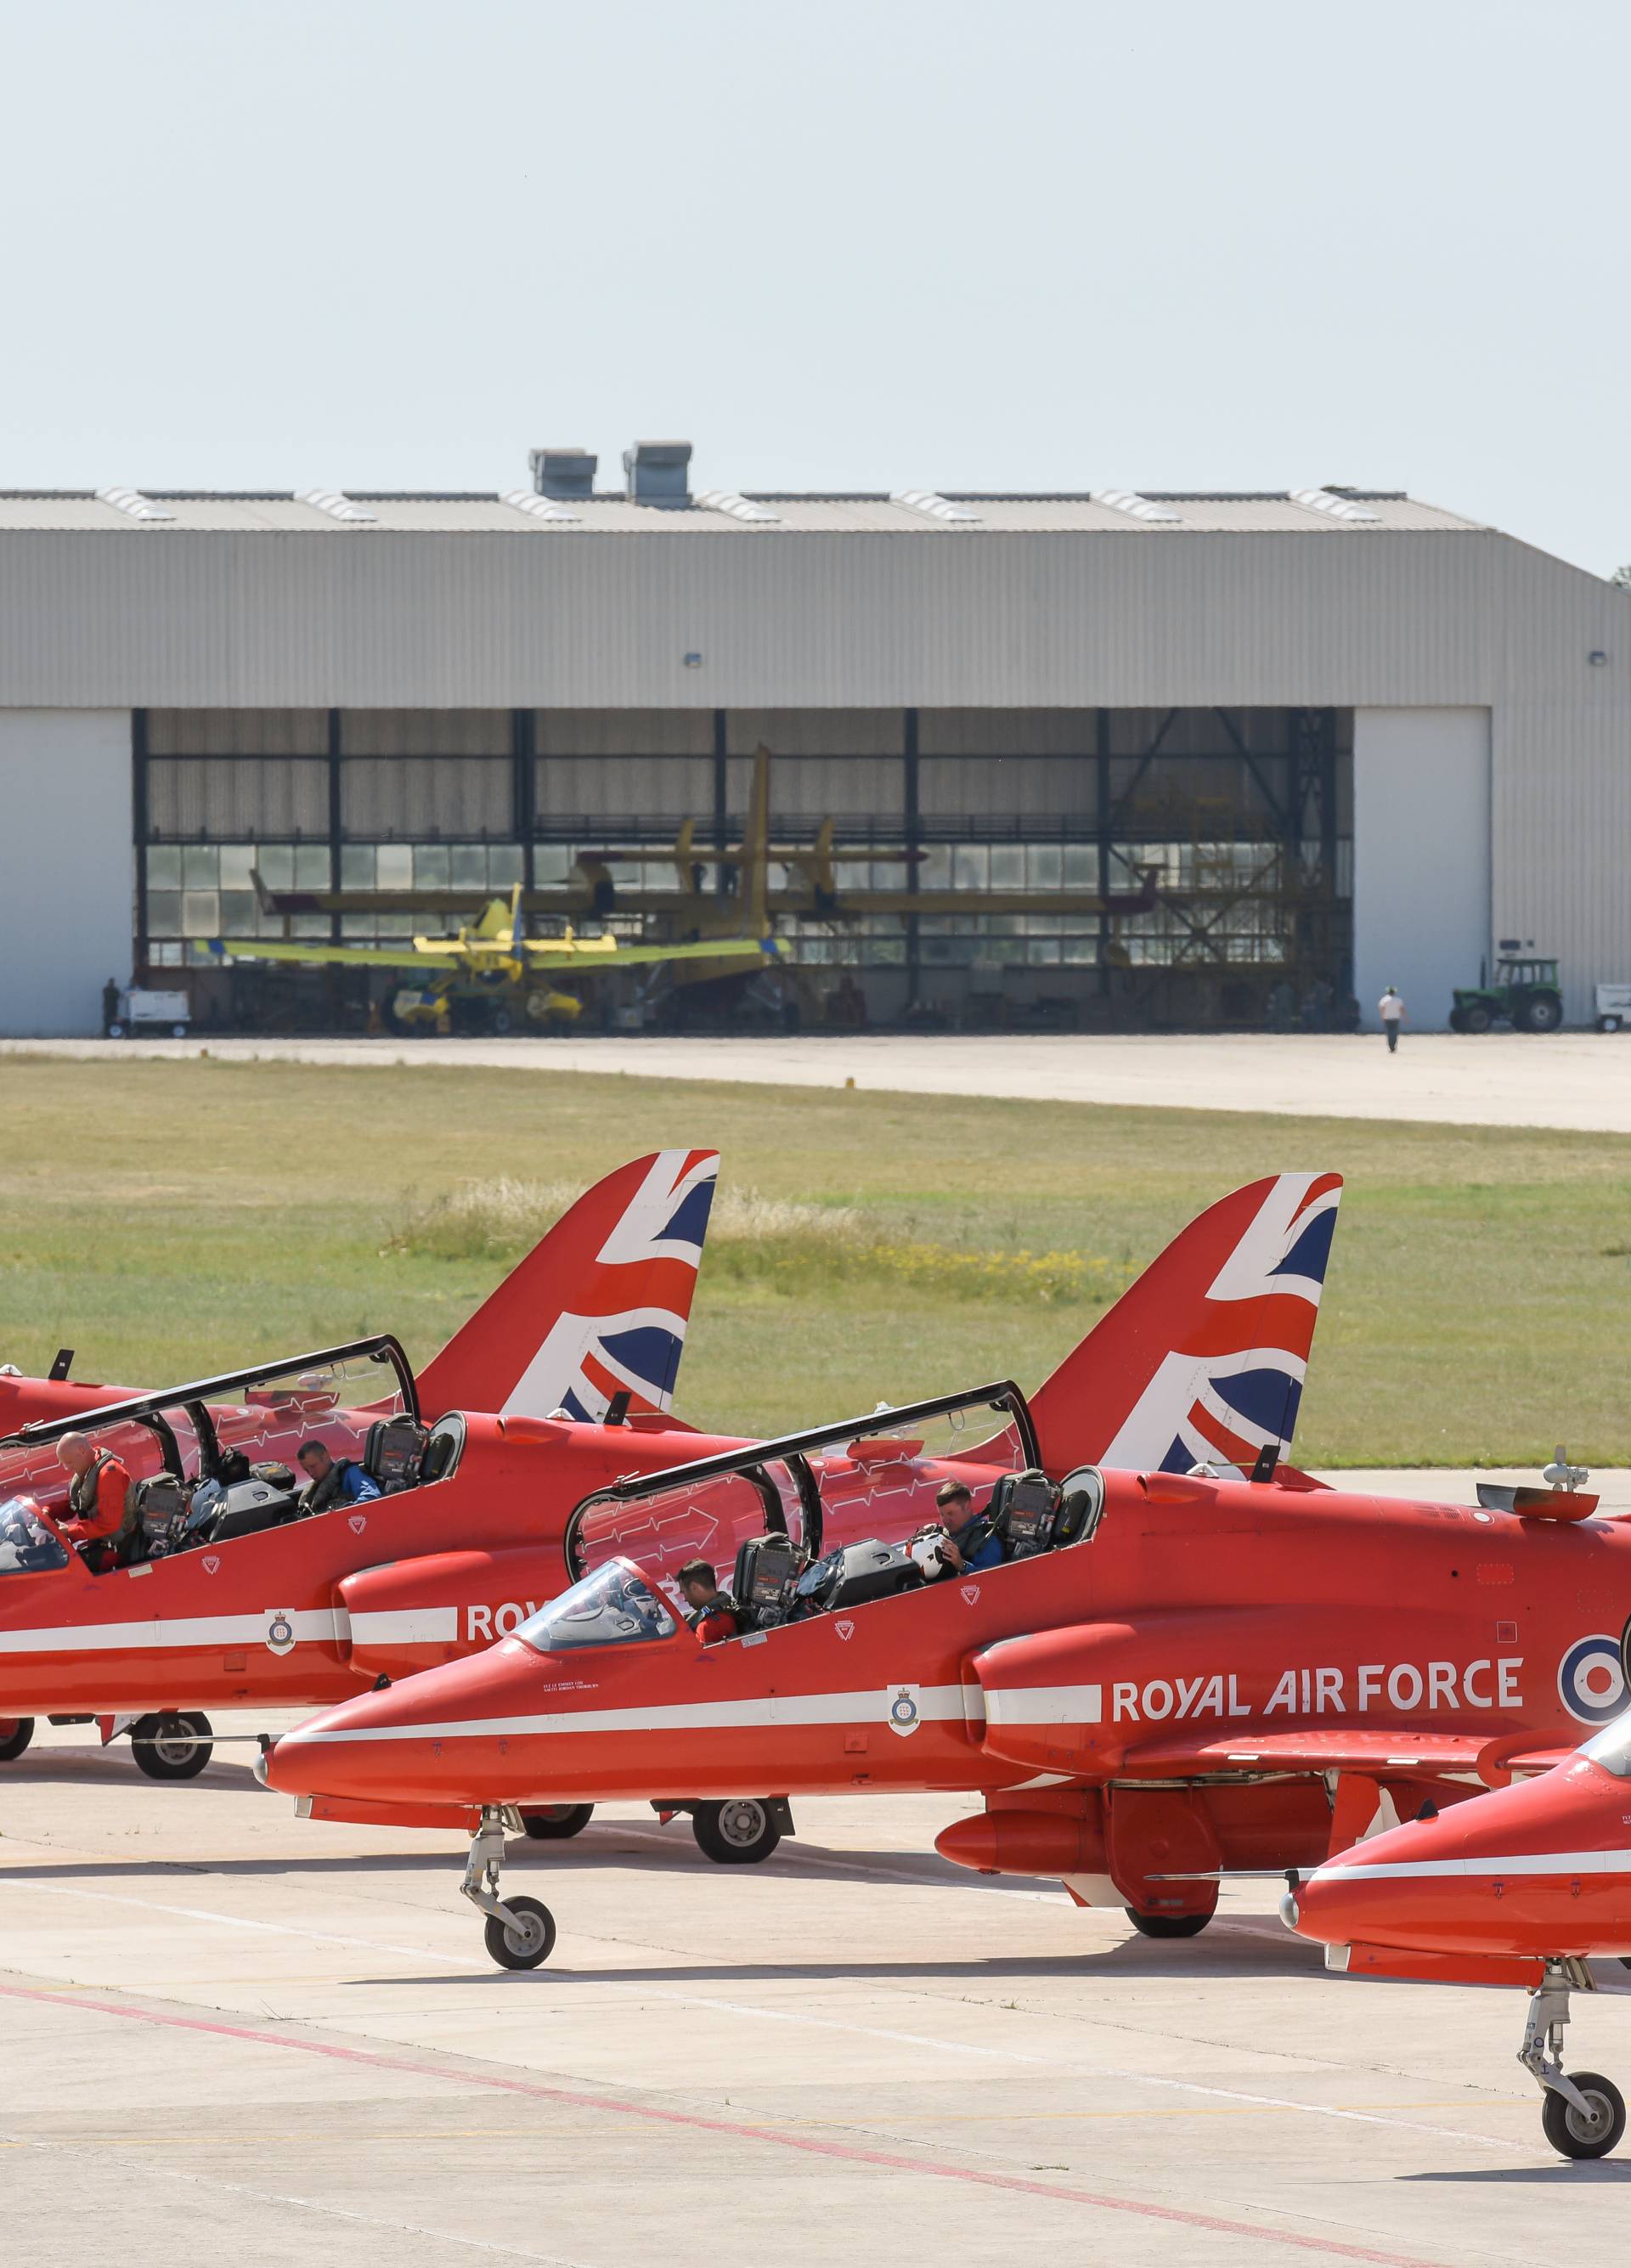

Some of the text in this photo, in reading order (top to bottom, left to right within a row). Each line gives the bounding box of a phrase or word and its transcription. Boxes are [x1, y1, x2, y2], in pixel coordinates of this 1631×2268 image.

[1113, 1658, 1523, 1722] ROYAL AIR FORCE
